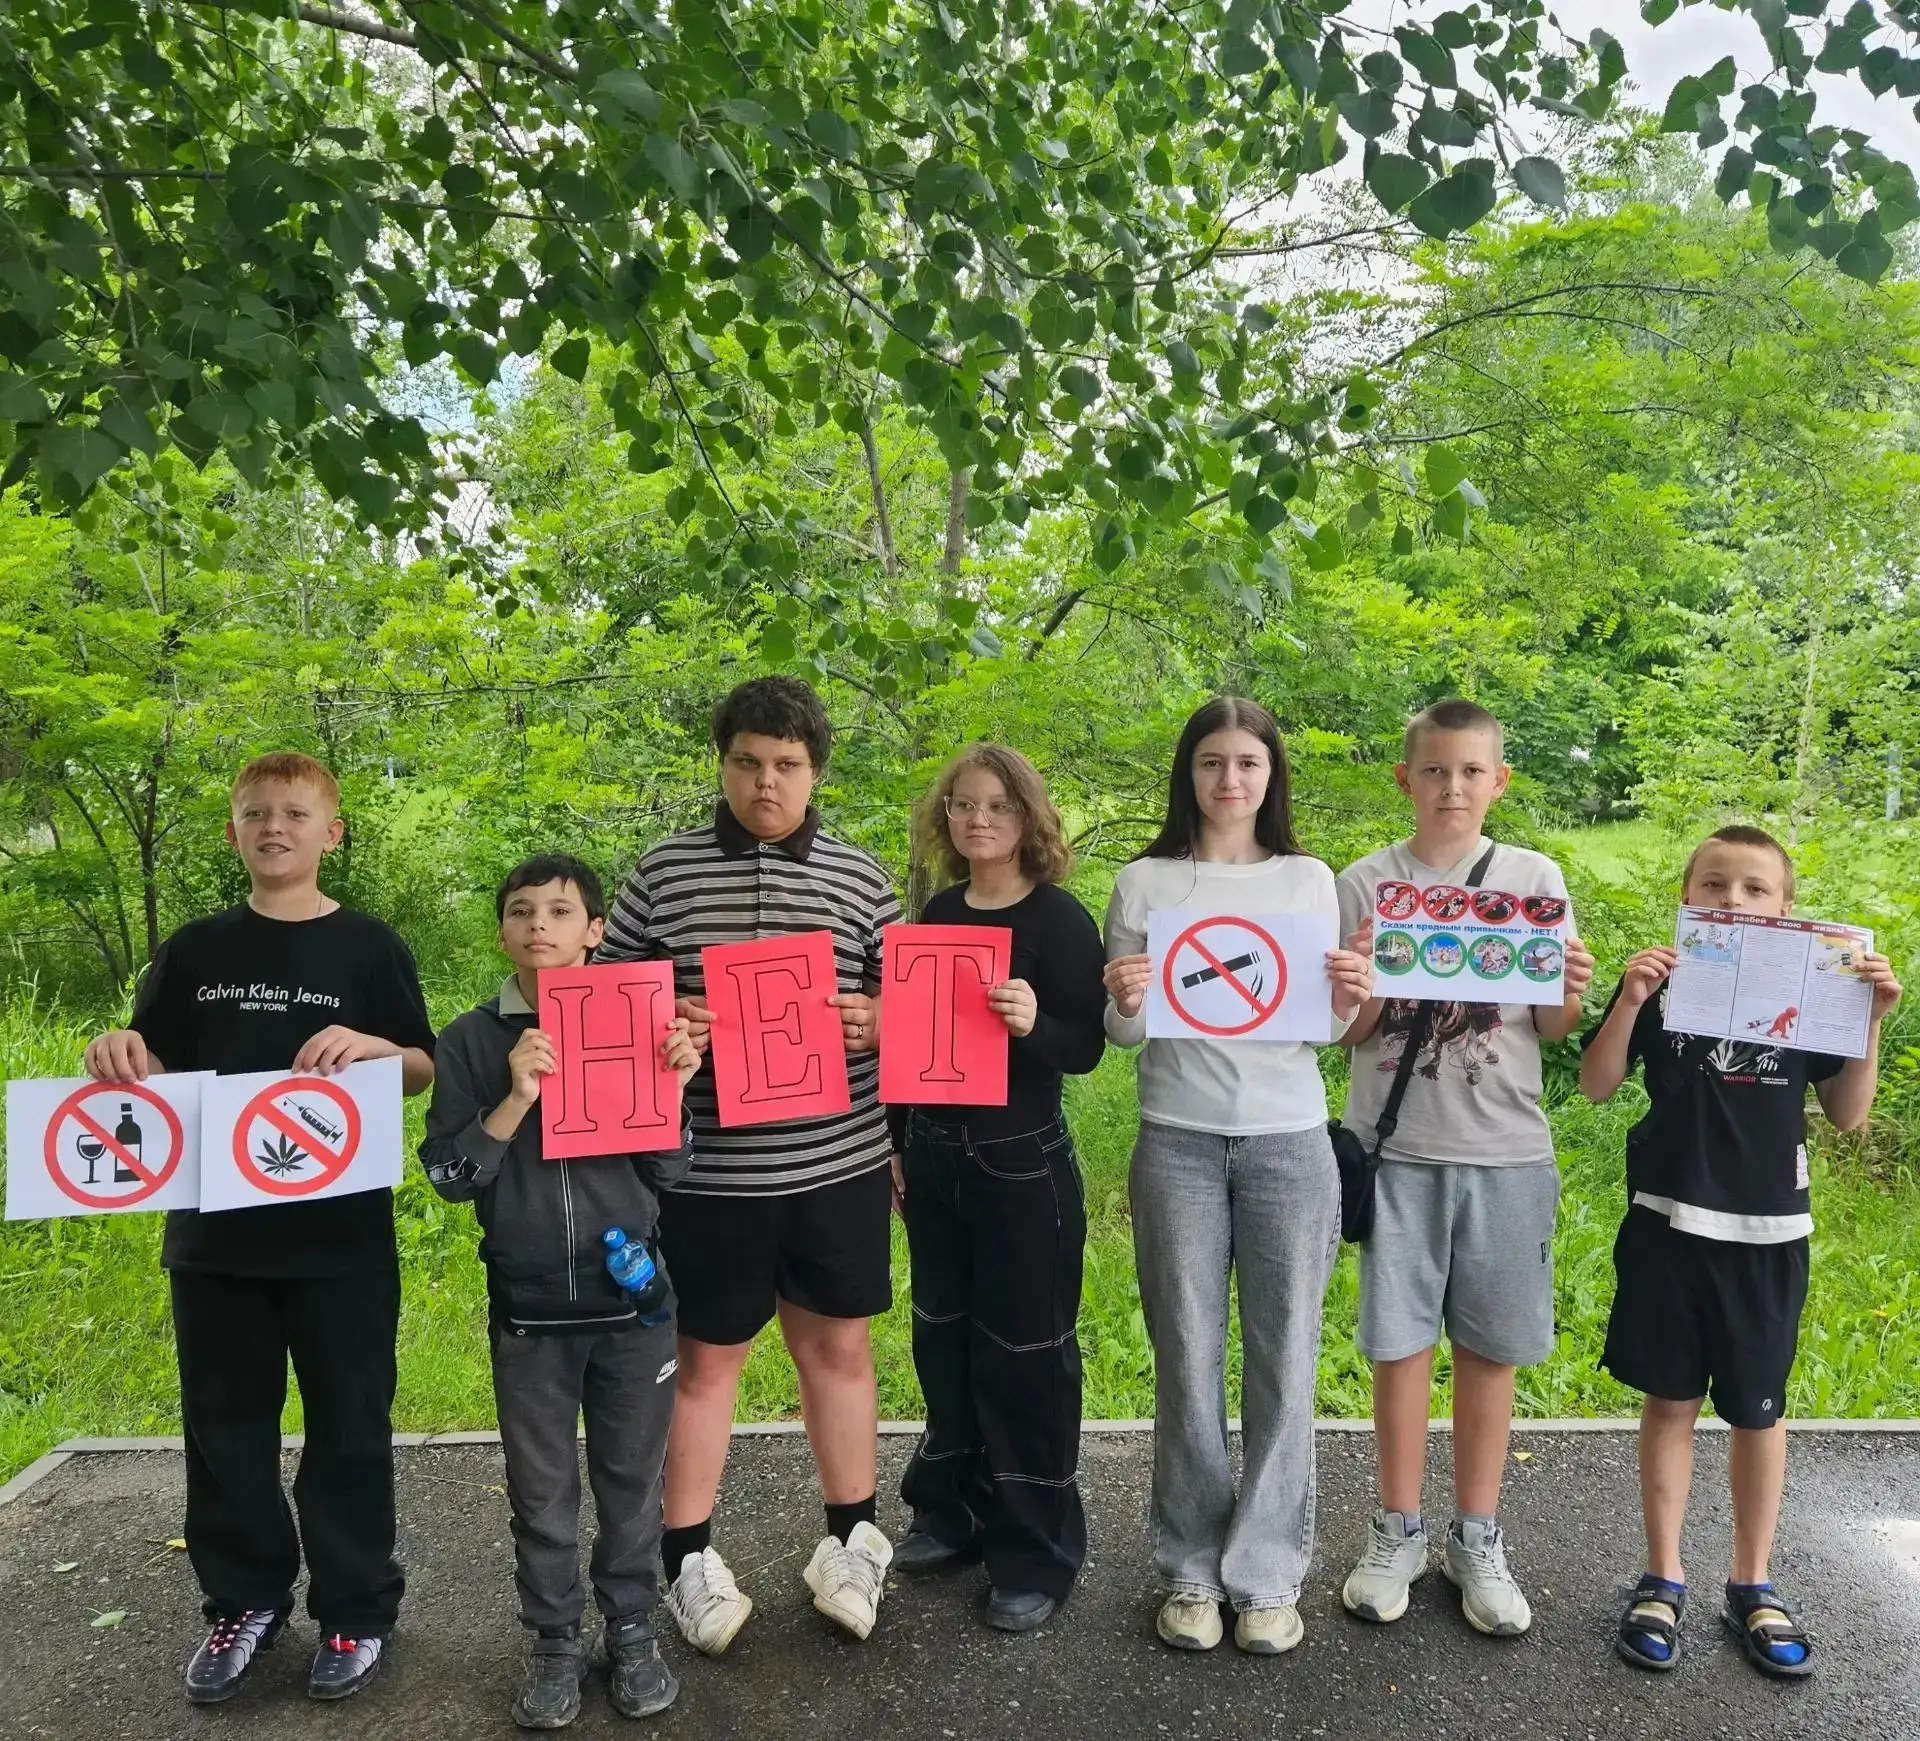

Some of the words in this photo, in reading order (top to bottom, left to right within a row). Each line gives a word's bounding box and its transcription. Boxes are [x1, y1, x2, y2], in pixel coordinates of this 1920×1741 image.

[1712, 911, 1726, 919] Не
[1732, 915, 1767, 925] разбей
[1776, 920, 1802, 929] свою
[1380, 921, 1414, 930] Скажи
[1464, 925, 1522, 934] привычкам
[197, 983, 245, 1002] Calvin
[248, 983, 289, 1001] Klein
[293, 986, 341, 1009] Jeans
[239, 1001, 262, 1011] NEW
[262, 1002, 288, 1012] YORK
[1723, 1074, 1757, 1084] WARRIOR
